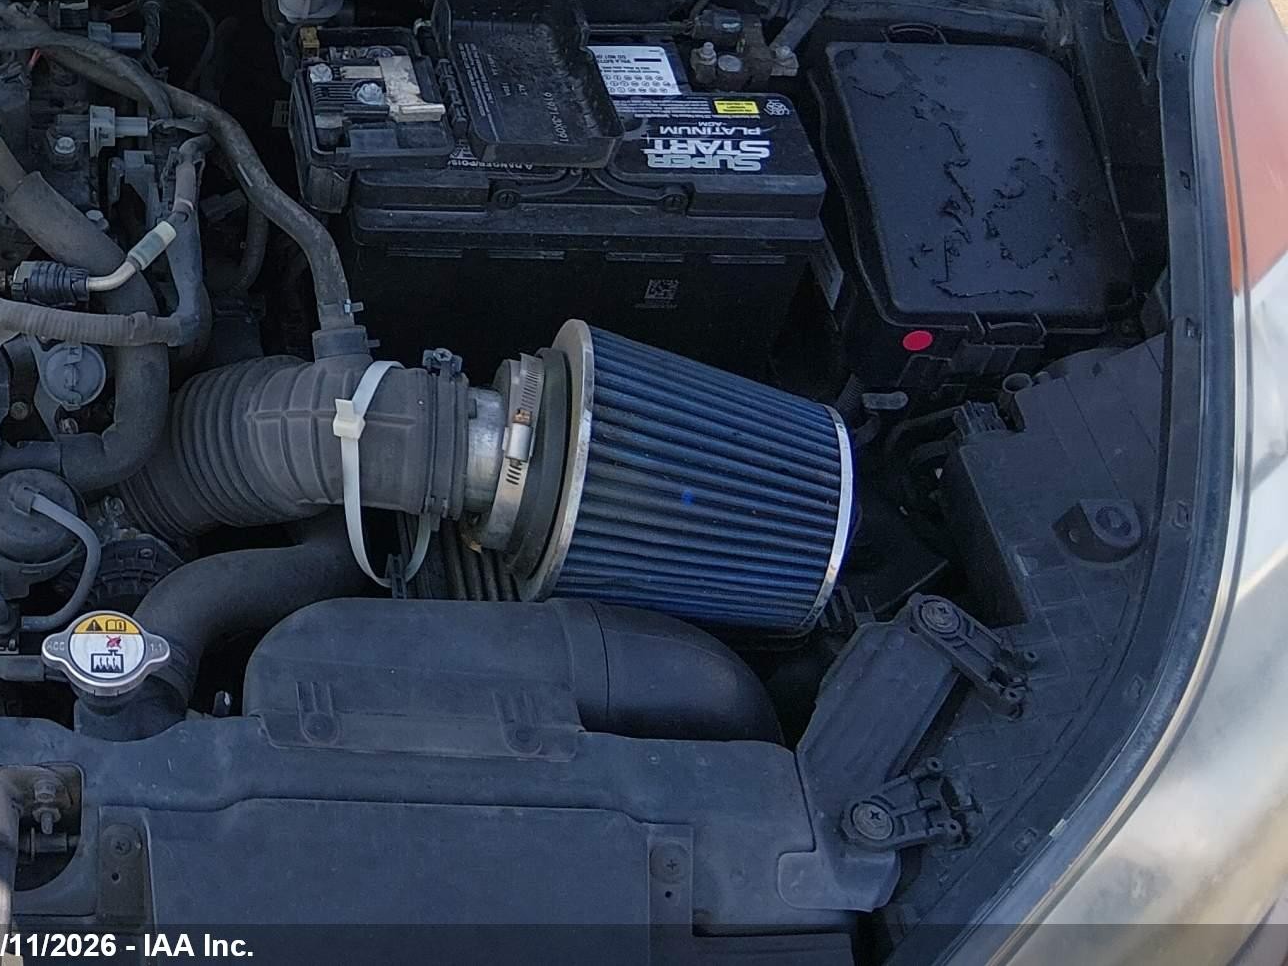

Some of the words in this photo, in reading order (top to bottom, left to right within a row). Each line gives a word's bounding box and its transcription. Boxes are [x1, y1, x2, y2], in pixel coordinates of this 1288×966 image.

[659, 126, 761, 136] PLATINUM
[641, 139, 770, 159] START
[647, 153, 762, 171] SUPER
